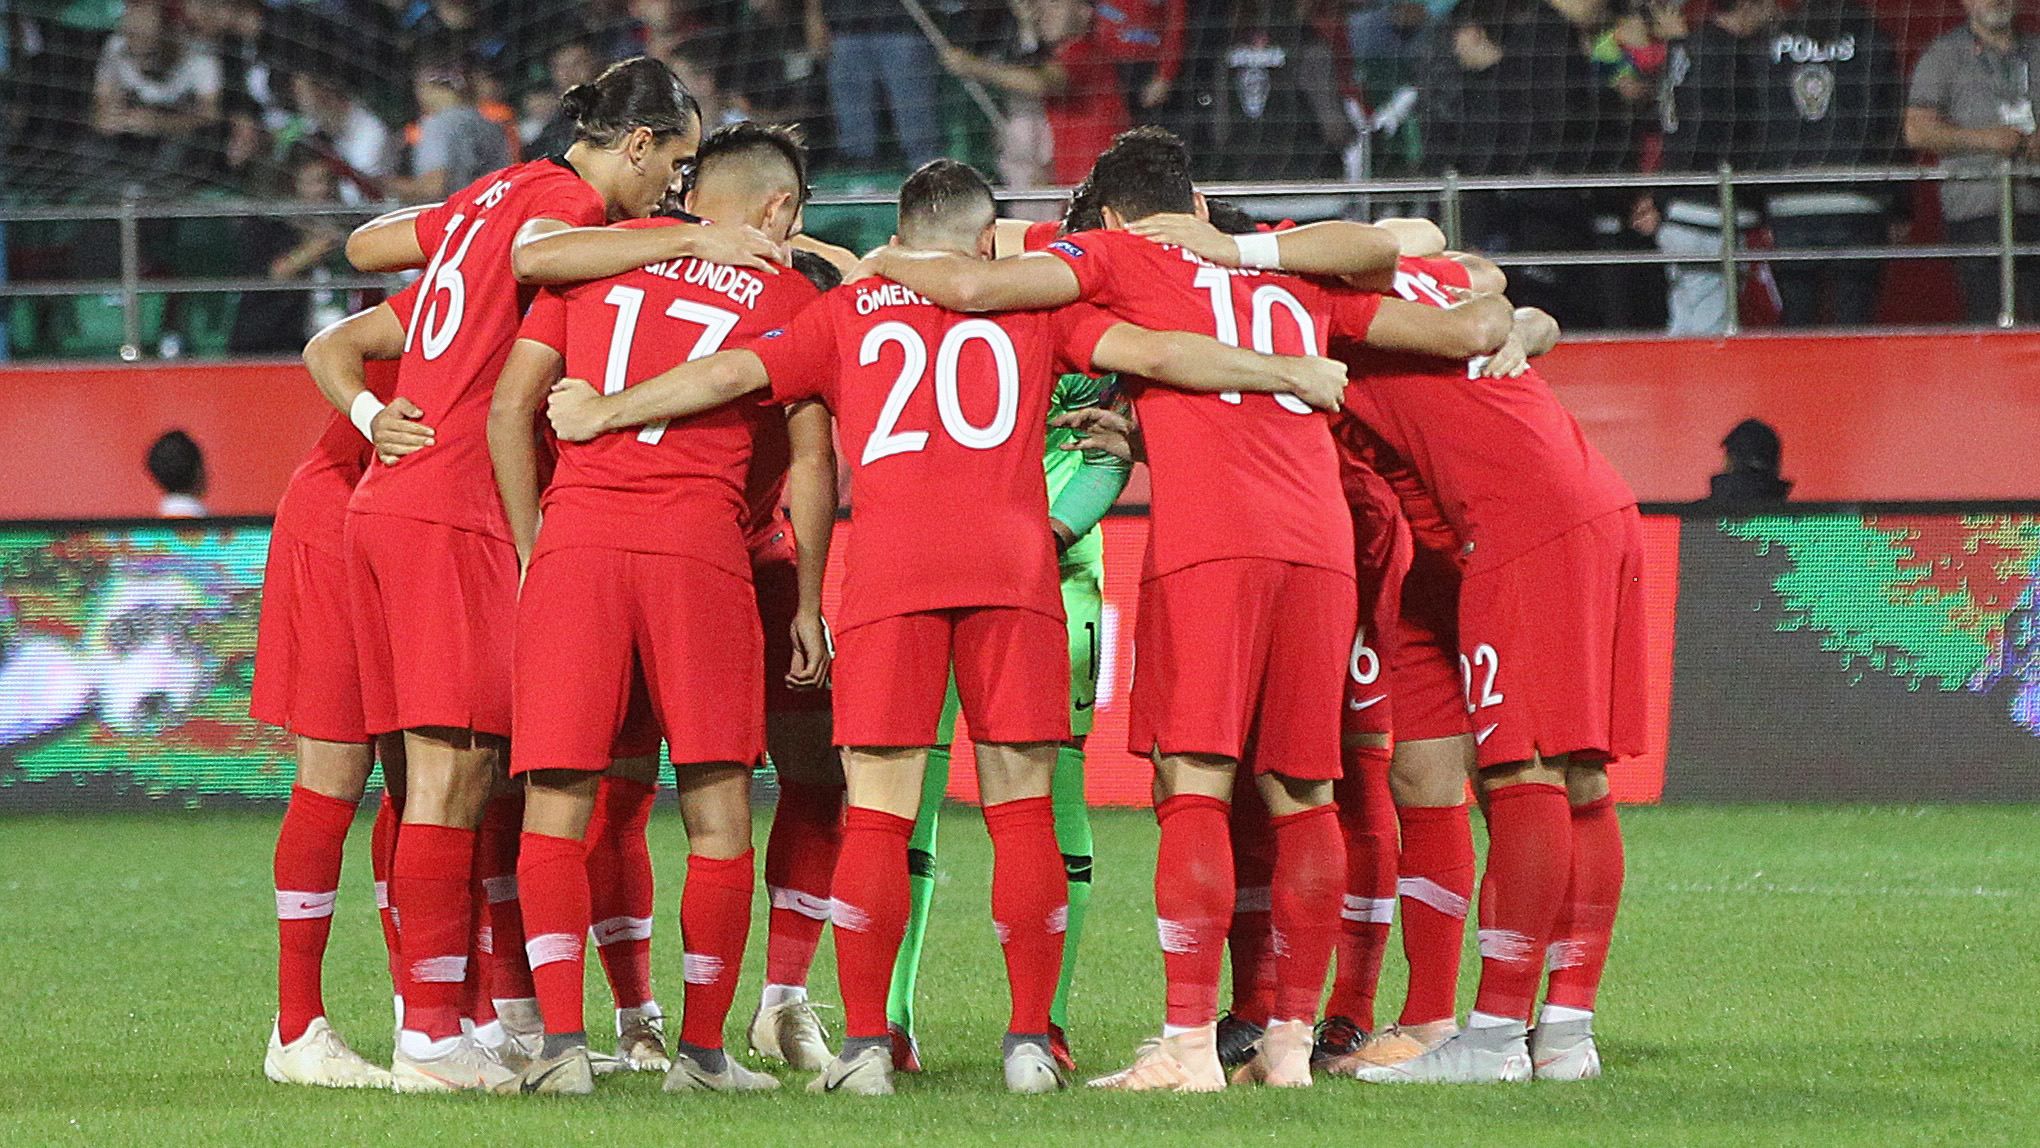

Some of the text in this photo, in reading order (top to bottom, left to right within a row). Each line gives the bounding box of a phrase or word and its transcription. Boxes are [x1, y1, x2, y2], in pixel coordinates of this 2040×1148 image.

[404, 213, 486, 361] 16
[1193, 267, 1318, 414] 10
[604, 284, 741, 445] 17
[859, 318, 1020, 466] 20
[1084, 622, 1095, 680] 1
